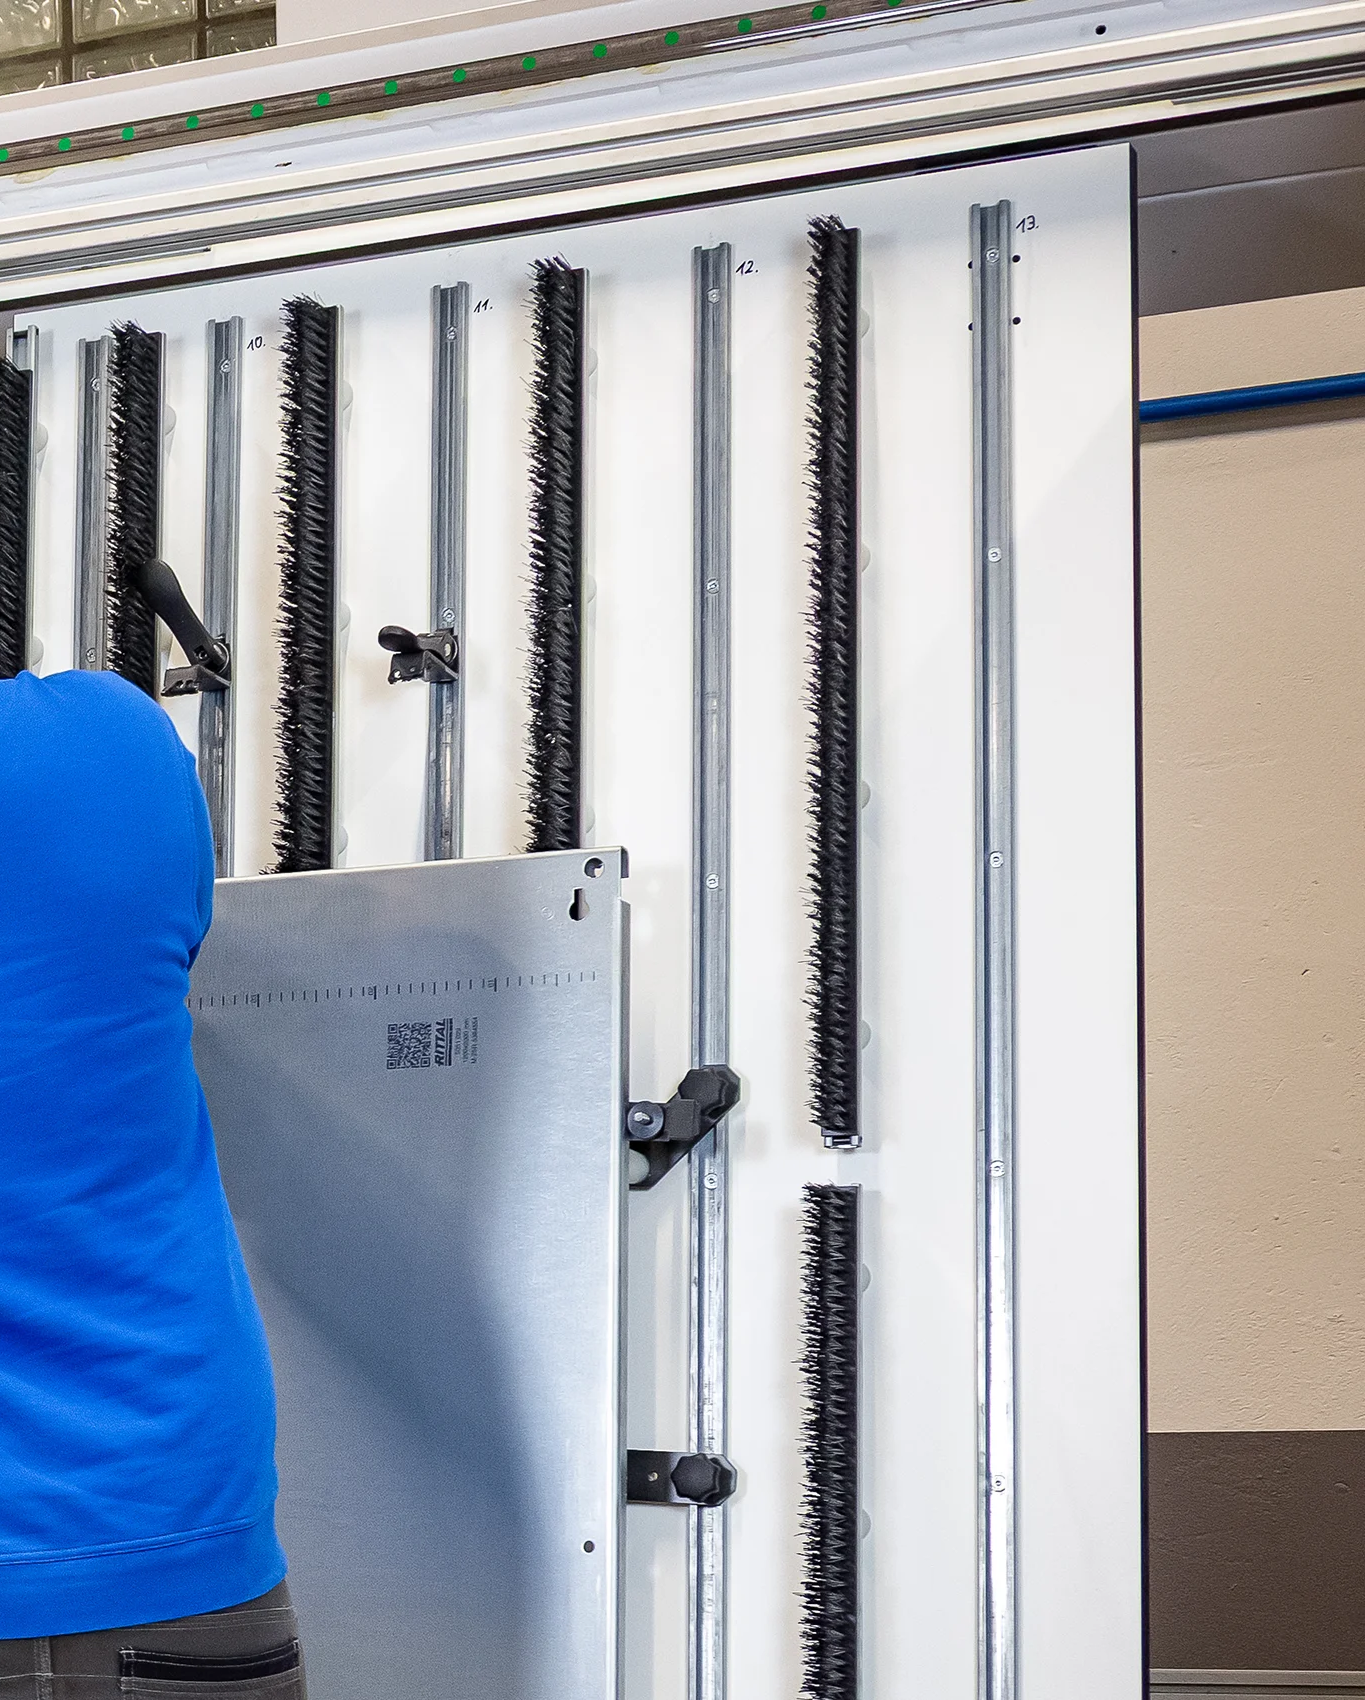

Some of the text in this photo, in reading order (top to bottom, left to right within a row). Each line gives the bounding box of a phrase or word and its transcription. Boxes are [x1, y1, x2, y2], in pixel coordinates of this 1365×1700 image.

[1015, 214, 1040, 233] 13.
[735, 259, 759, 276] 12.
[473, 298, 493, 314] 11.
[247, 335, 266, 351] 10.
[434, 1019, 446, 1066] RITTAL
